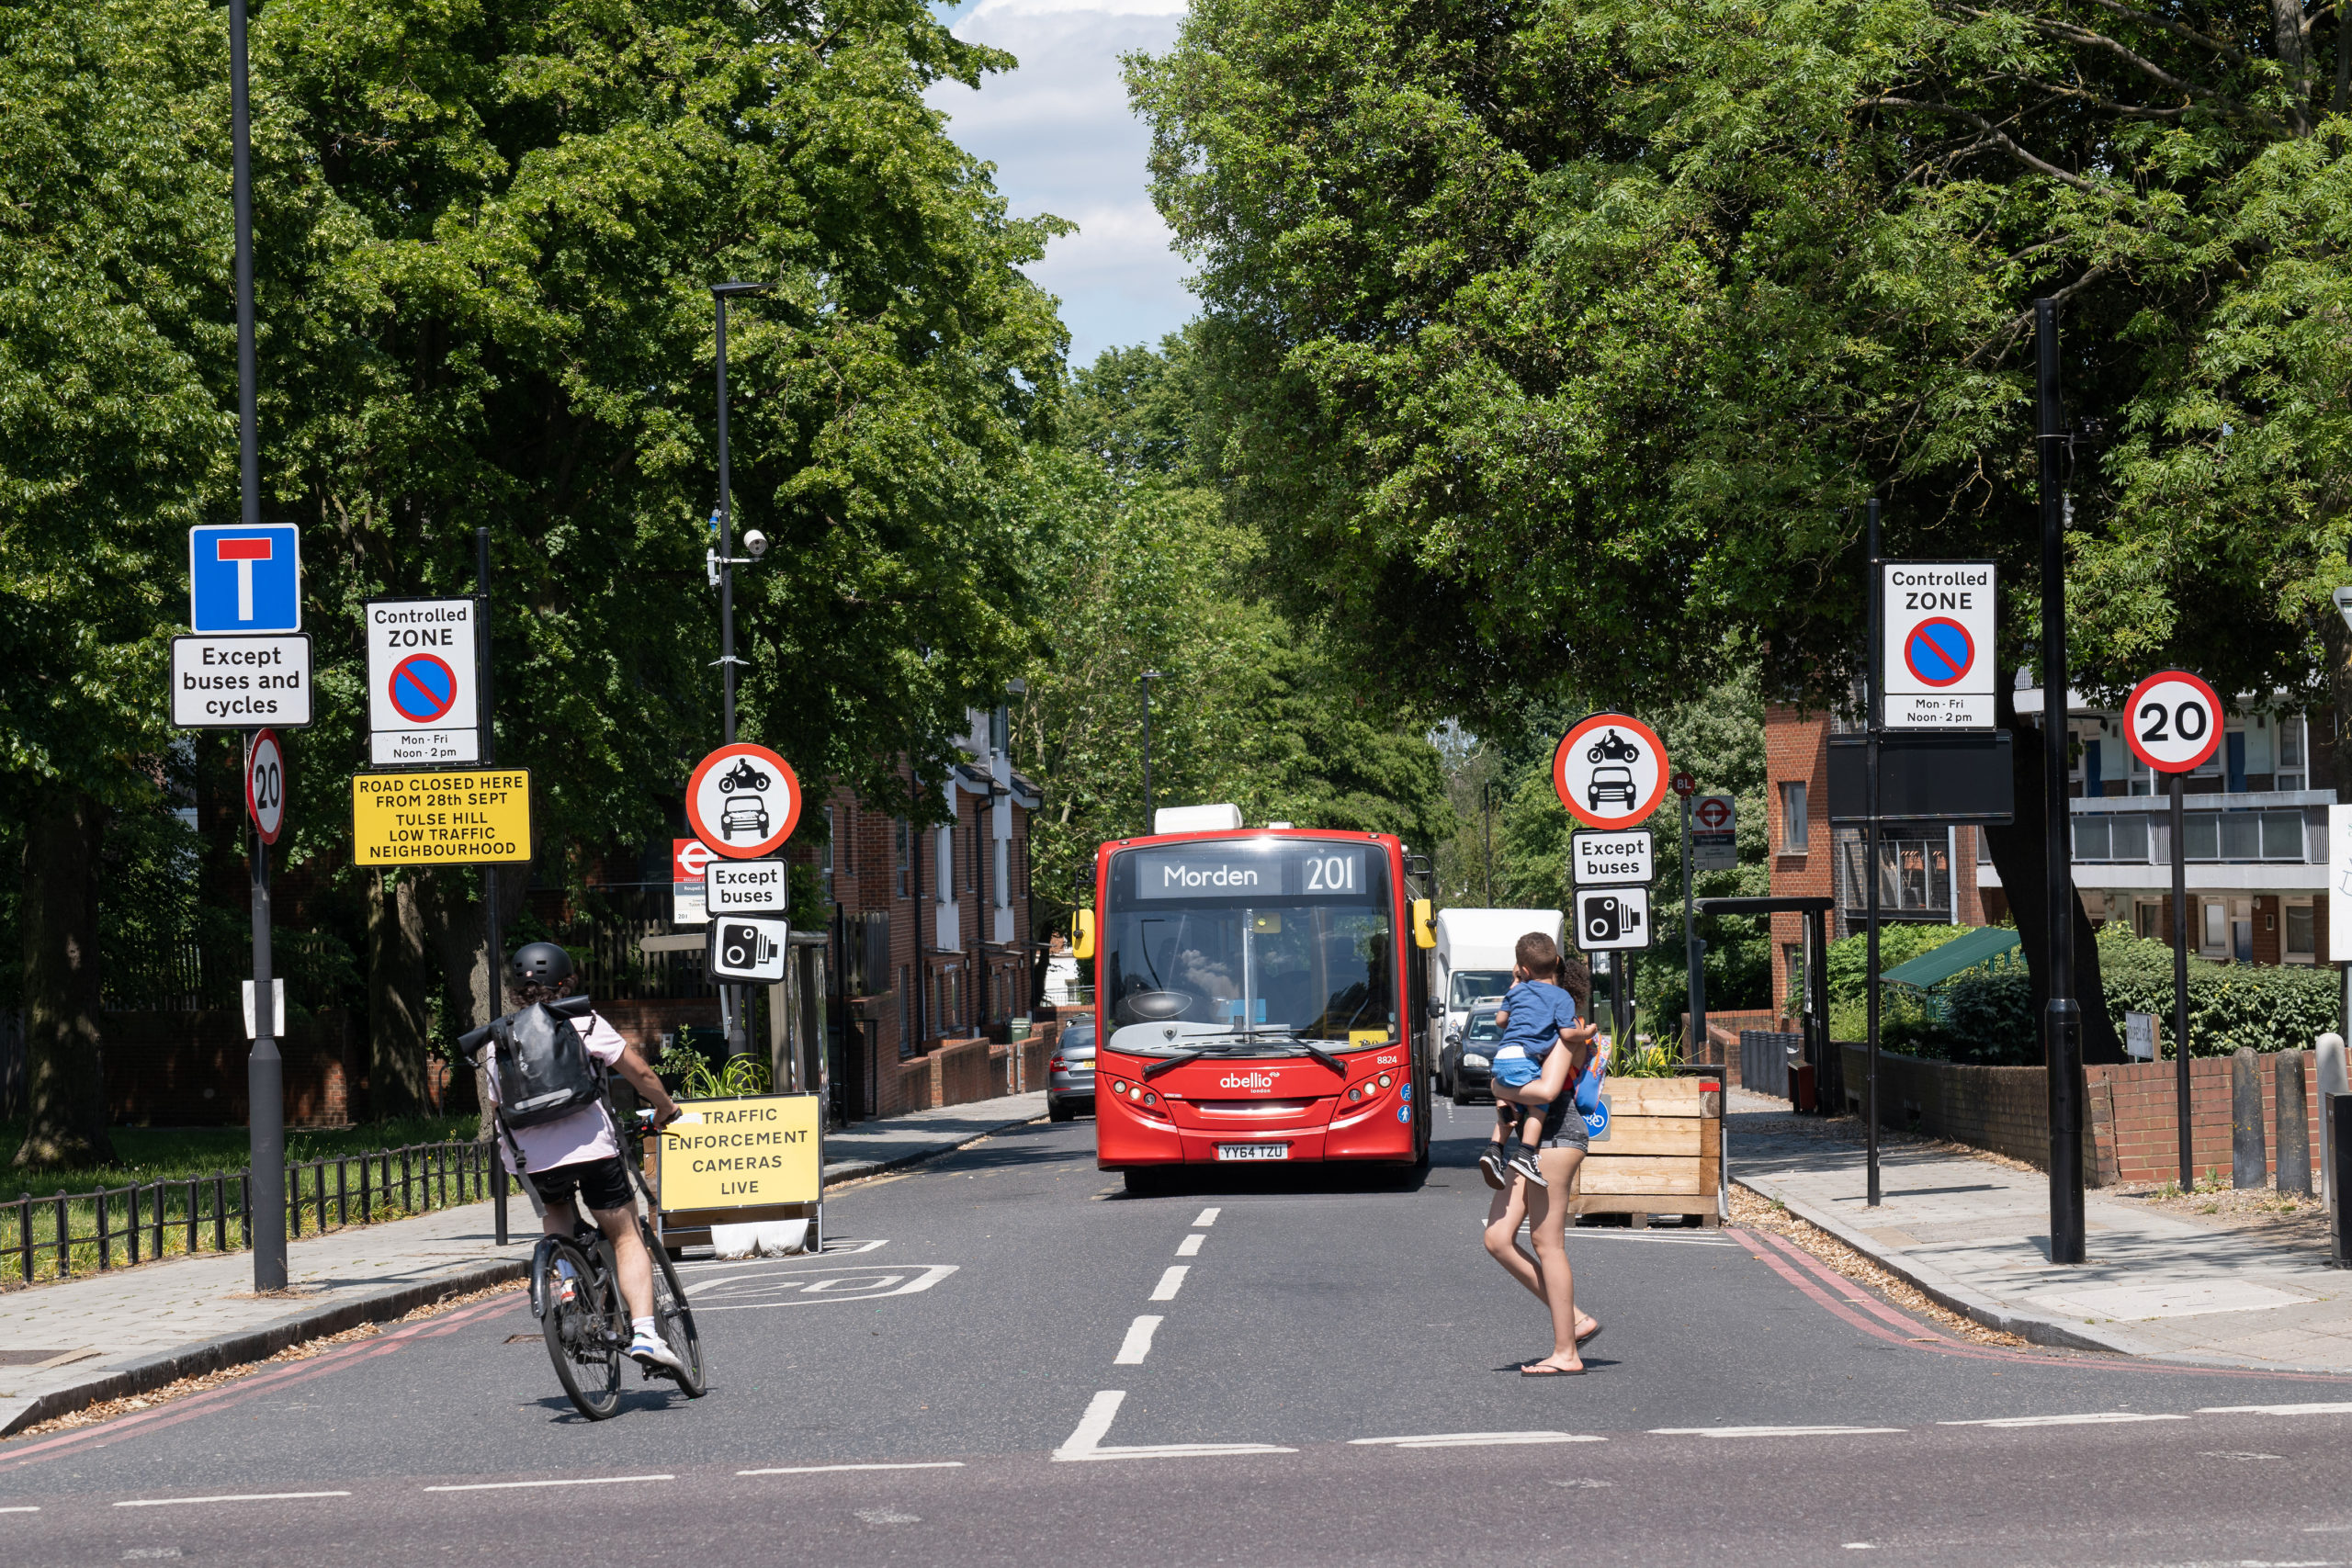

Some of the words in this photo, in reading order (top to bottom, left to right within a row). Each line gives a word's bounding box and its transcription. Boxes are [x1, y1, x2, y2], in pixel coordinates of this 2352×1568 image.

[1893, 571, 1986, 585] Controlled
[1906, 592, 1972, 610] ZONE
[375, 607, 466, 624] Controlled
[389, 628, 453, 647] ZONE
[203, 647, 281, 668] Except
[184, 672, 249, 690] buses
[259, 671, 299, 689] and
[206, 696, 277, 717] cycles
[1917, 700, 1939, 708] Mon
[1950, 700, 1962, 708] Fri
[1907, 713, 1936, 721] Noon
[1946, 713, 1952, 721] 2
[1956, 715, 1972, 723] pm
[2140, 701, 2207, 742] 20
[401, 736, 424, 744] Mon
[435, 735, 447, 743] Fri
[394, 750, 422, 758] Noon
[431, 748, 437, 756] 2
[441, 750, 457, 759] pm
[255, 762, 280, 810] 20
[360, 781, 403, 793] ROAD
[410, 778, 473, 791] CLOSED
[481, 776, 523, 788] HERE
[1678, 779, 1690, 789] BL
[377, 795, 420, 807] FROM
[427, 795, 461, 806] 28th
[469, 793, 507, 805] SEPT
[396, 813, 446, 826] TULSE
[454, 812, 488, 824] HILL
[390, 829, 424, 841] LOW
[429, 828, 494, 840] TRAFFIC
[370, 842, 515, 858] NEIGHBOURHOOD
[1582, 840, 1644, 856] Except
[1165, 865, 1257, 886] Morden
[1307, 857, 1352, 889] 201
[1588, 861, 1639, 874] buses
[716, 869, 777, 886] Except
[721, 889, 772, 903] buses
[1377, 1055, 1396, 1064] 8824
[1219, 1071, 1272, 1089] abellio
[703, 1109, 776, 1123] TRAFFIC
[668, 1131, 808, 1150] ENFORCEMENT
[1224, 1146, 1255, 1158] YY64
[1259, 1146, 1283, 1157] TZU
[693, 1156, 781, 1172] CAMERAS
[722, 1181, 758, 1194] LIVE
